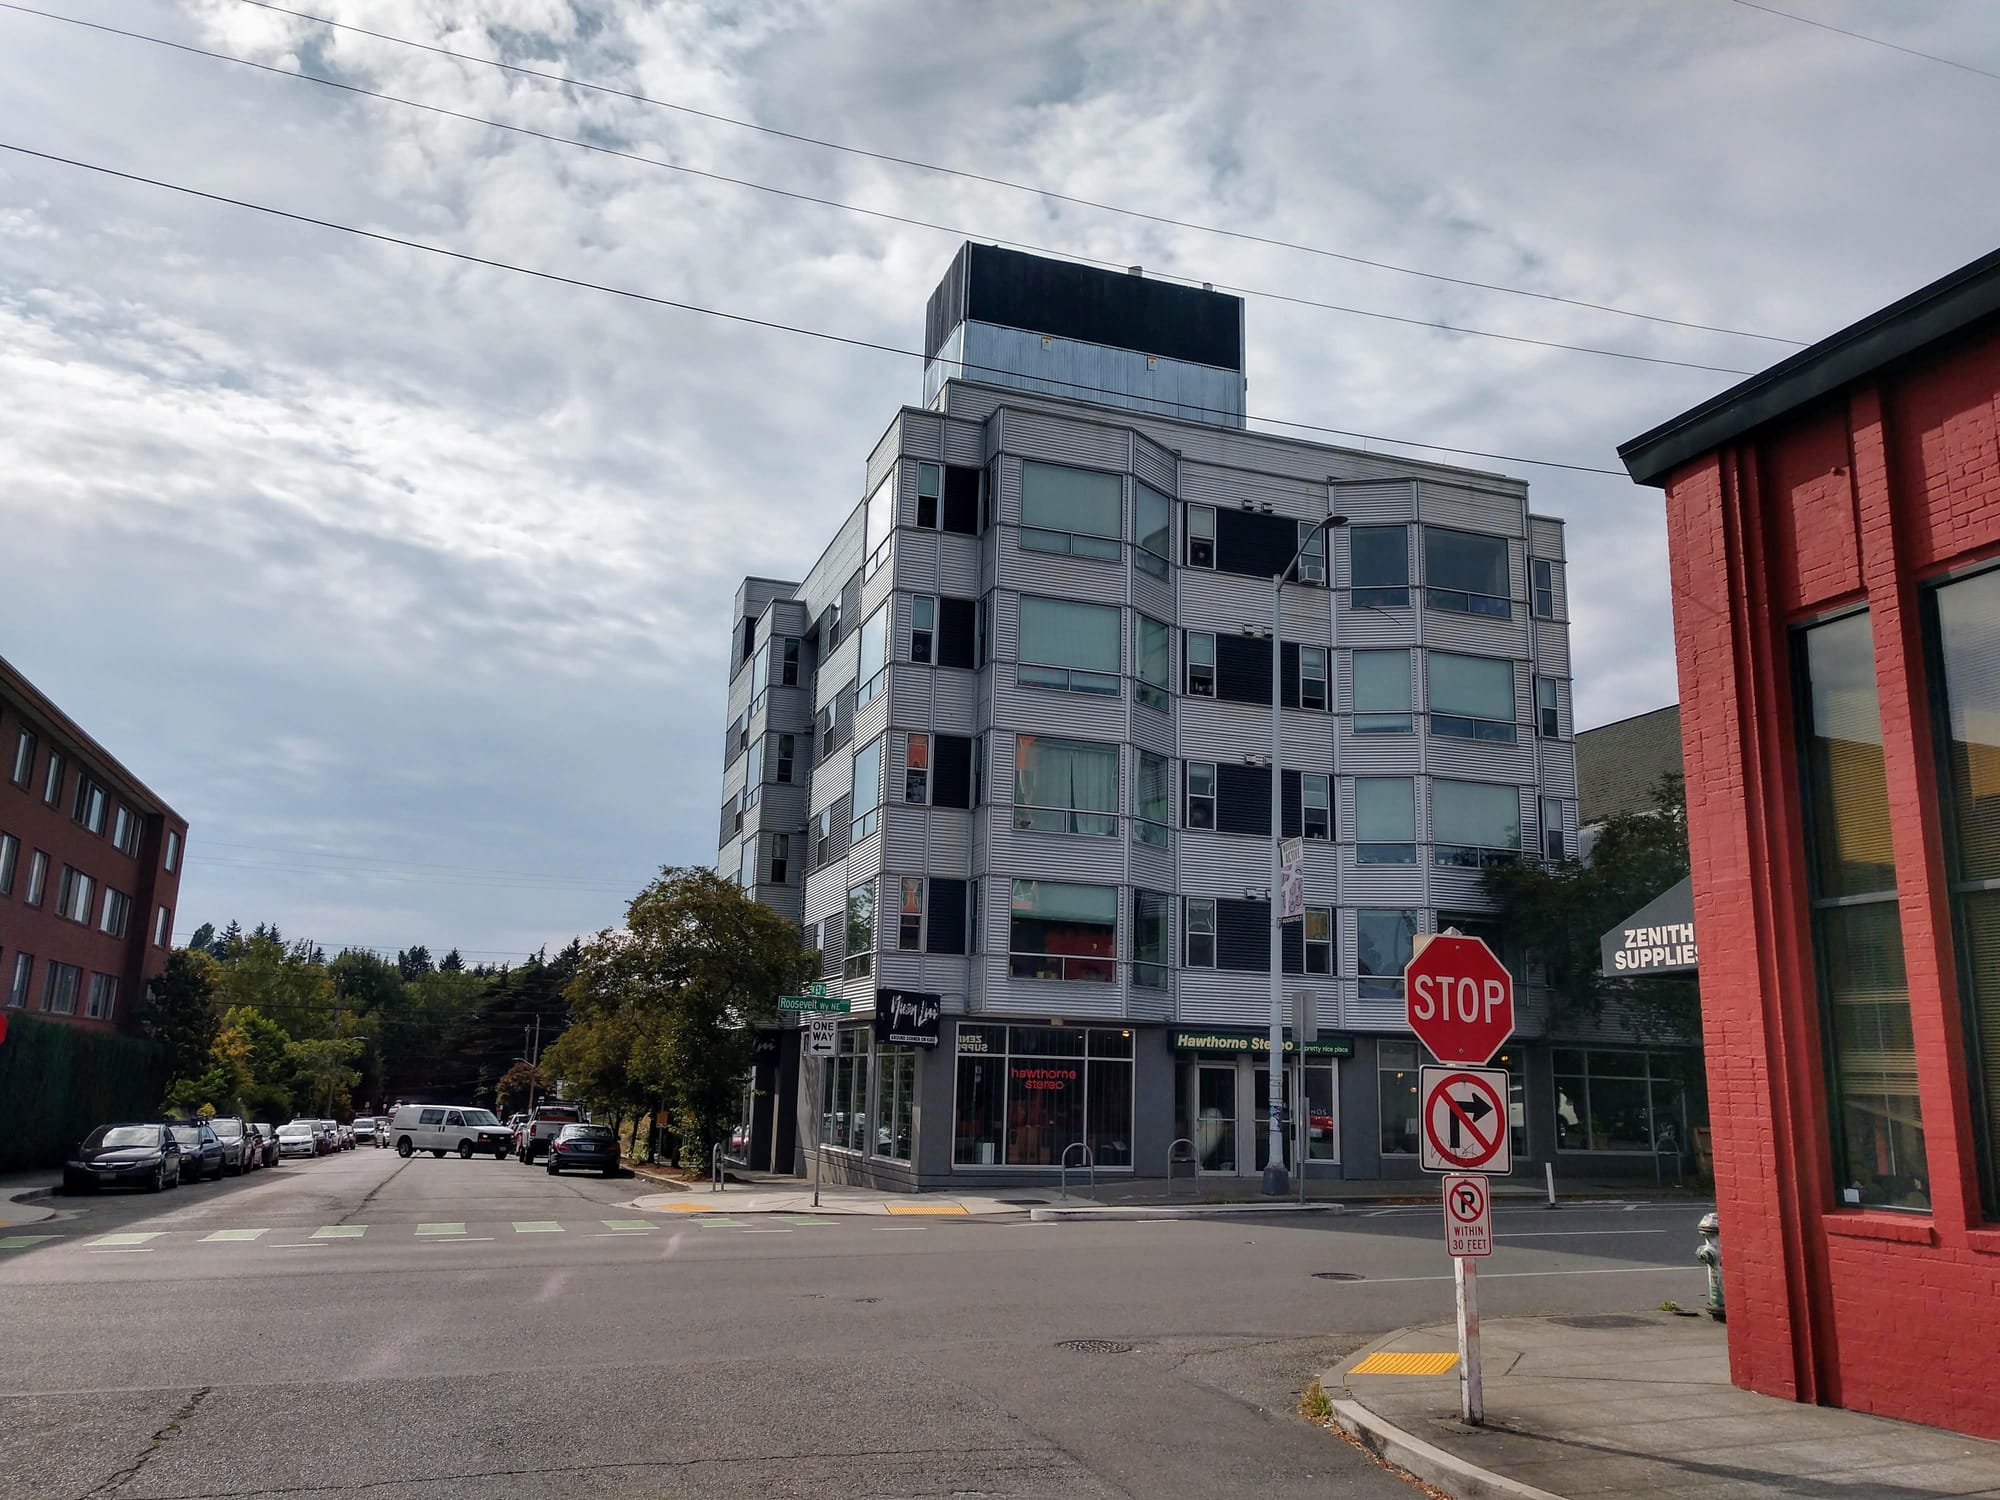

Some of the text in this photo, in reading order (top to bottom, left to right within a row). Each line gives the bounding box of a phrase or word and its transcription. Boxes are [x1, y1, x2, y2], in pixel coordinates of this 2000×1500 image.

[1624, 923, 1694, 948] ZENITH
[1615, 944, 1699, 970] SUPPLIE
[780, 997, 818, 1010] Roosevelt
[830, 1003, 841, 1011] NE
[1414, 974, 1504, 1024] STOP
[813, 1021, 834, 1031] ONE
[812, 1031, 834, 1041] WAY
[1178, 1034, 1294, 1051] Hawthorne Steo
[1304, 1045, 1321, 1053] pretty
[1011, 1067, 1077, 1080] hawthorne
[1025, 1080, 1064, 1090] stereo
[1453, 1225, 1484, 1236] WITHIN
[1452, 1239, 1487, 1250] 30 FEET
